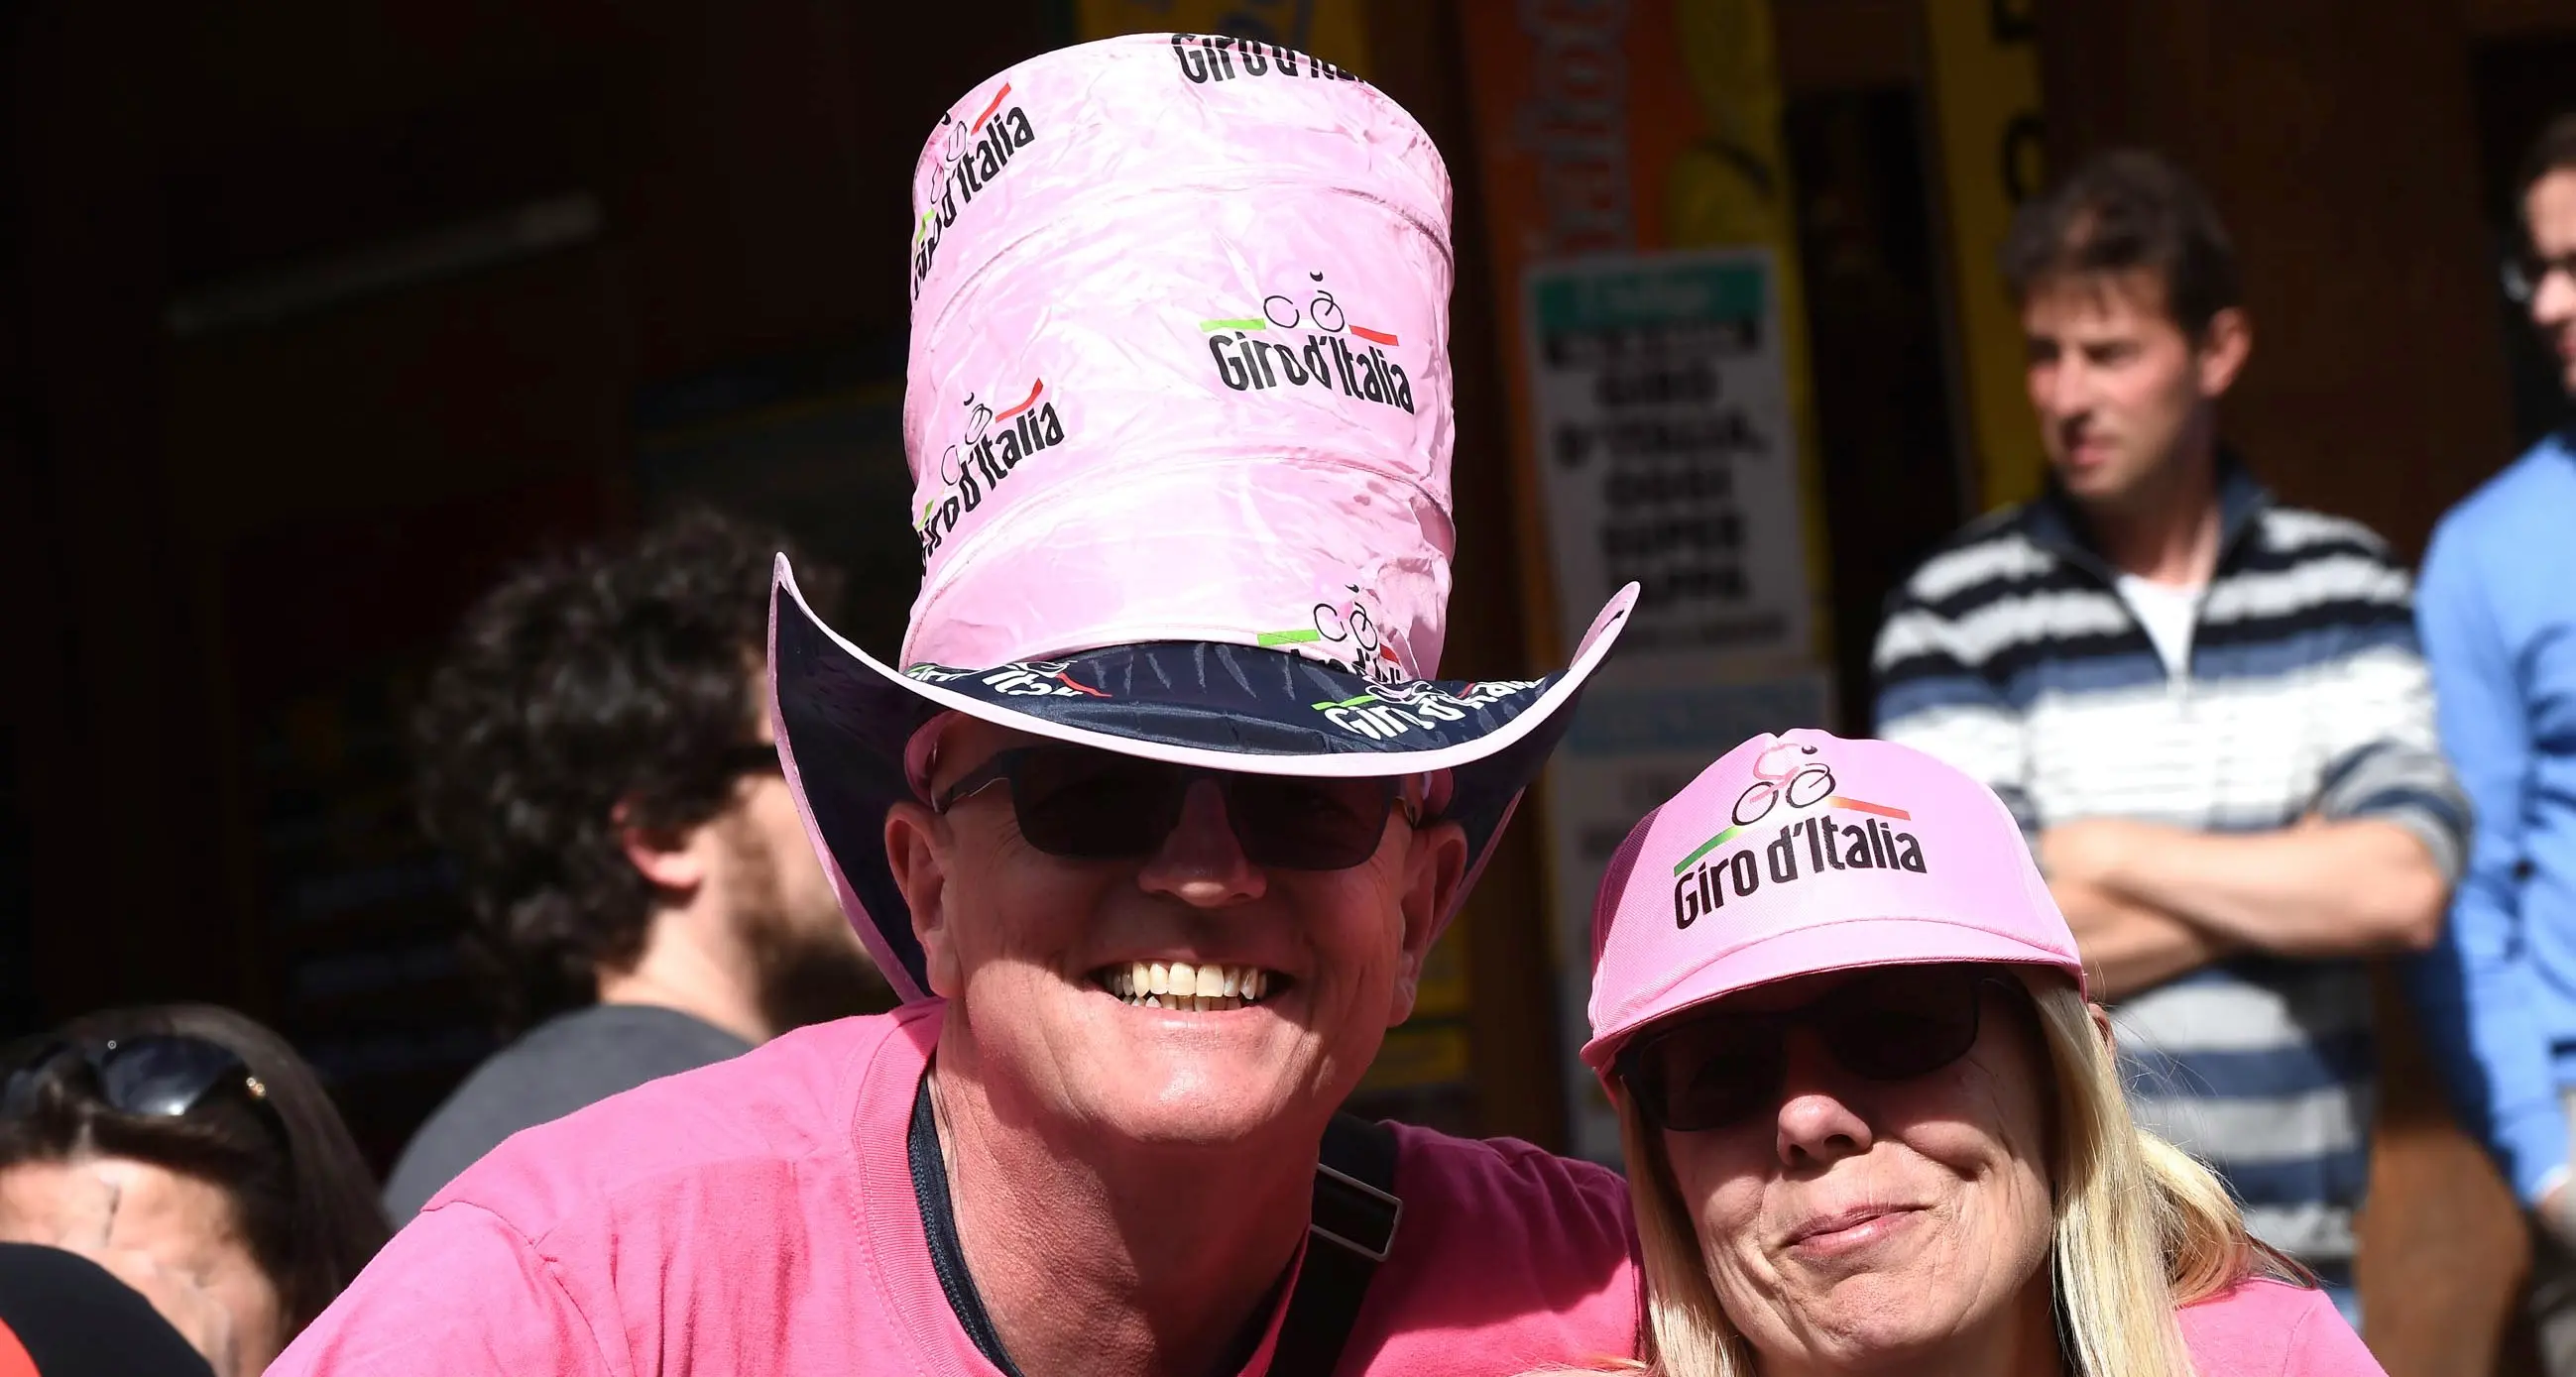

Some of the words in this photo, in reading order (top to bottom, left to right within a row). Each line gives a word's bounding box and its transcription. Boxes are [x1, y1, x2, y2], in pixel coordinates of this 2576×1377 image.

[942, 107, 1035, 228] d'Italia
[1209, 330, 1309, 391] Giro
[1303, 334, 1414, 415] d'Italia
[959, 402, 1065, 513] d'Italia
[1675, 849, 1760, 930] Giro
[1767, 814, 1928, 884] d'Italia
